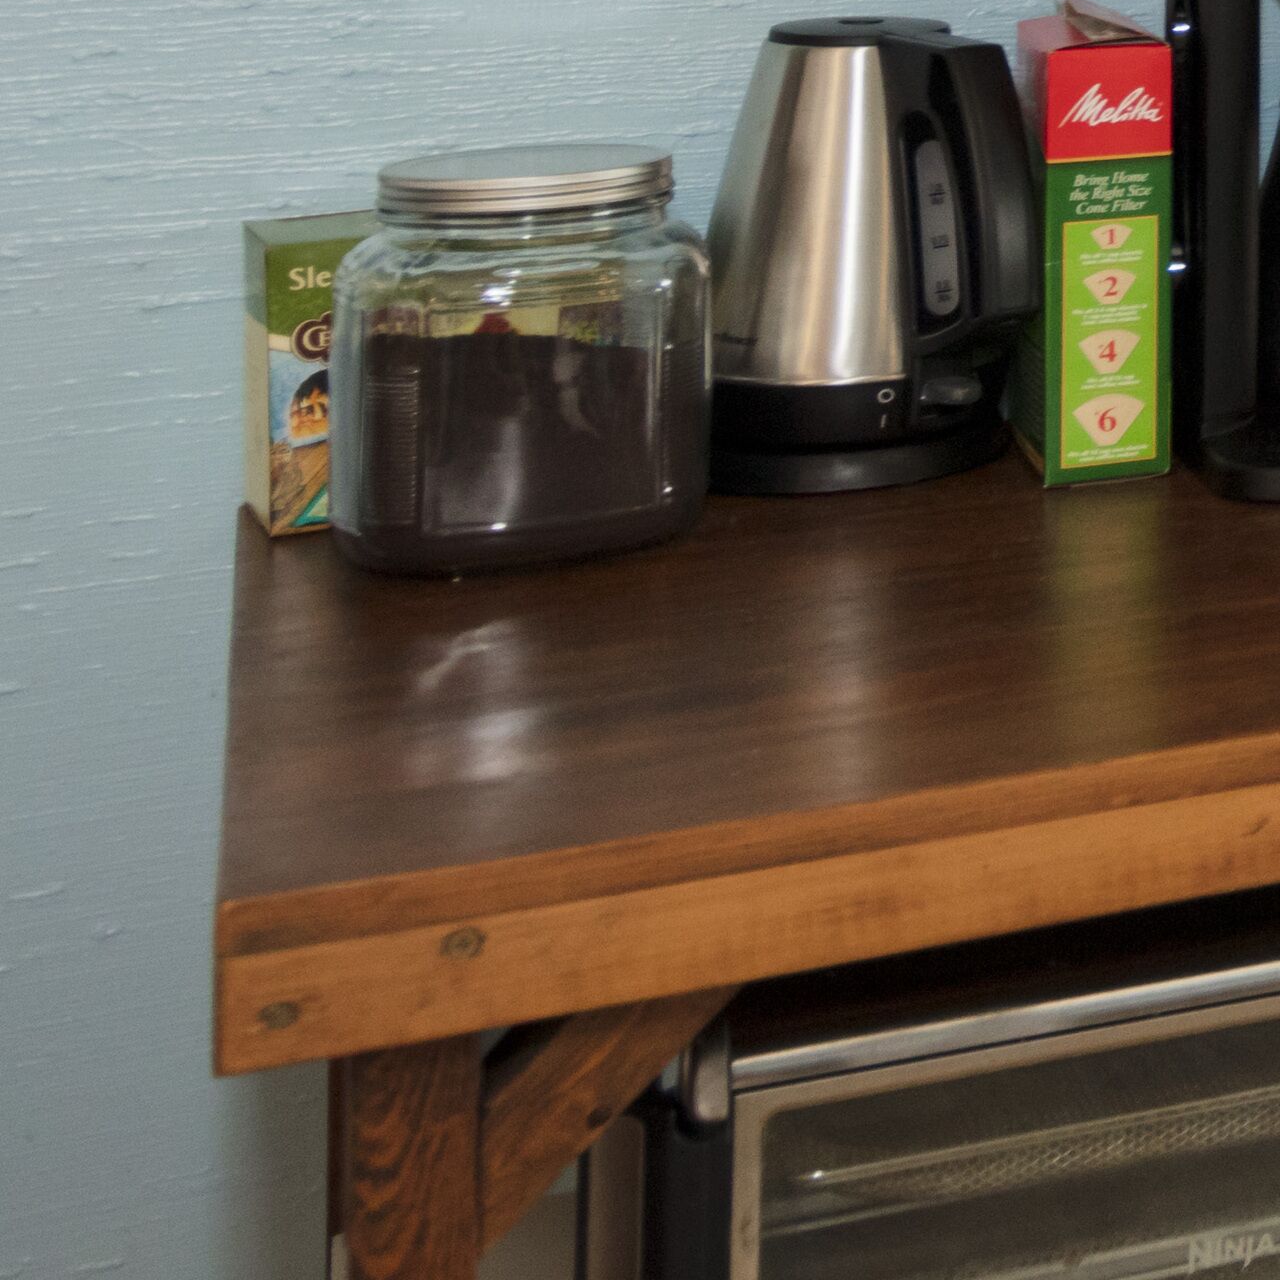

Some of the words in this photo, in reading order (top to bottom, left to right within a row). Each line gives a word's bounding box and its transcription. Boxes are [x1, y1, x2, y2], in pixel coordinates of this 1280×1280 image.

[1058, 83, 1163, 128] Melitta
[1073, 174, 1109, 189] Bring
[1111, 171, 1150, 184] Home
[1069, 187, 1090, 201] the
[1091, 185, 1126, 201] Right
[1126, 184, 1153, 197] Size
[1075, 201, 1110, 215] Cone
[1111, 198, 1148, 212] Filter
[1106, 228, 1116, 246] 1
[1103, 275, 1119, 297] 2
[1098, 339, 1117, 363] 4
[1098, 406, 1117, 432] 6
